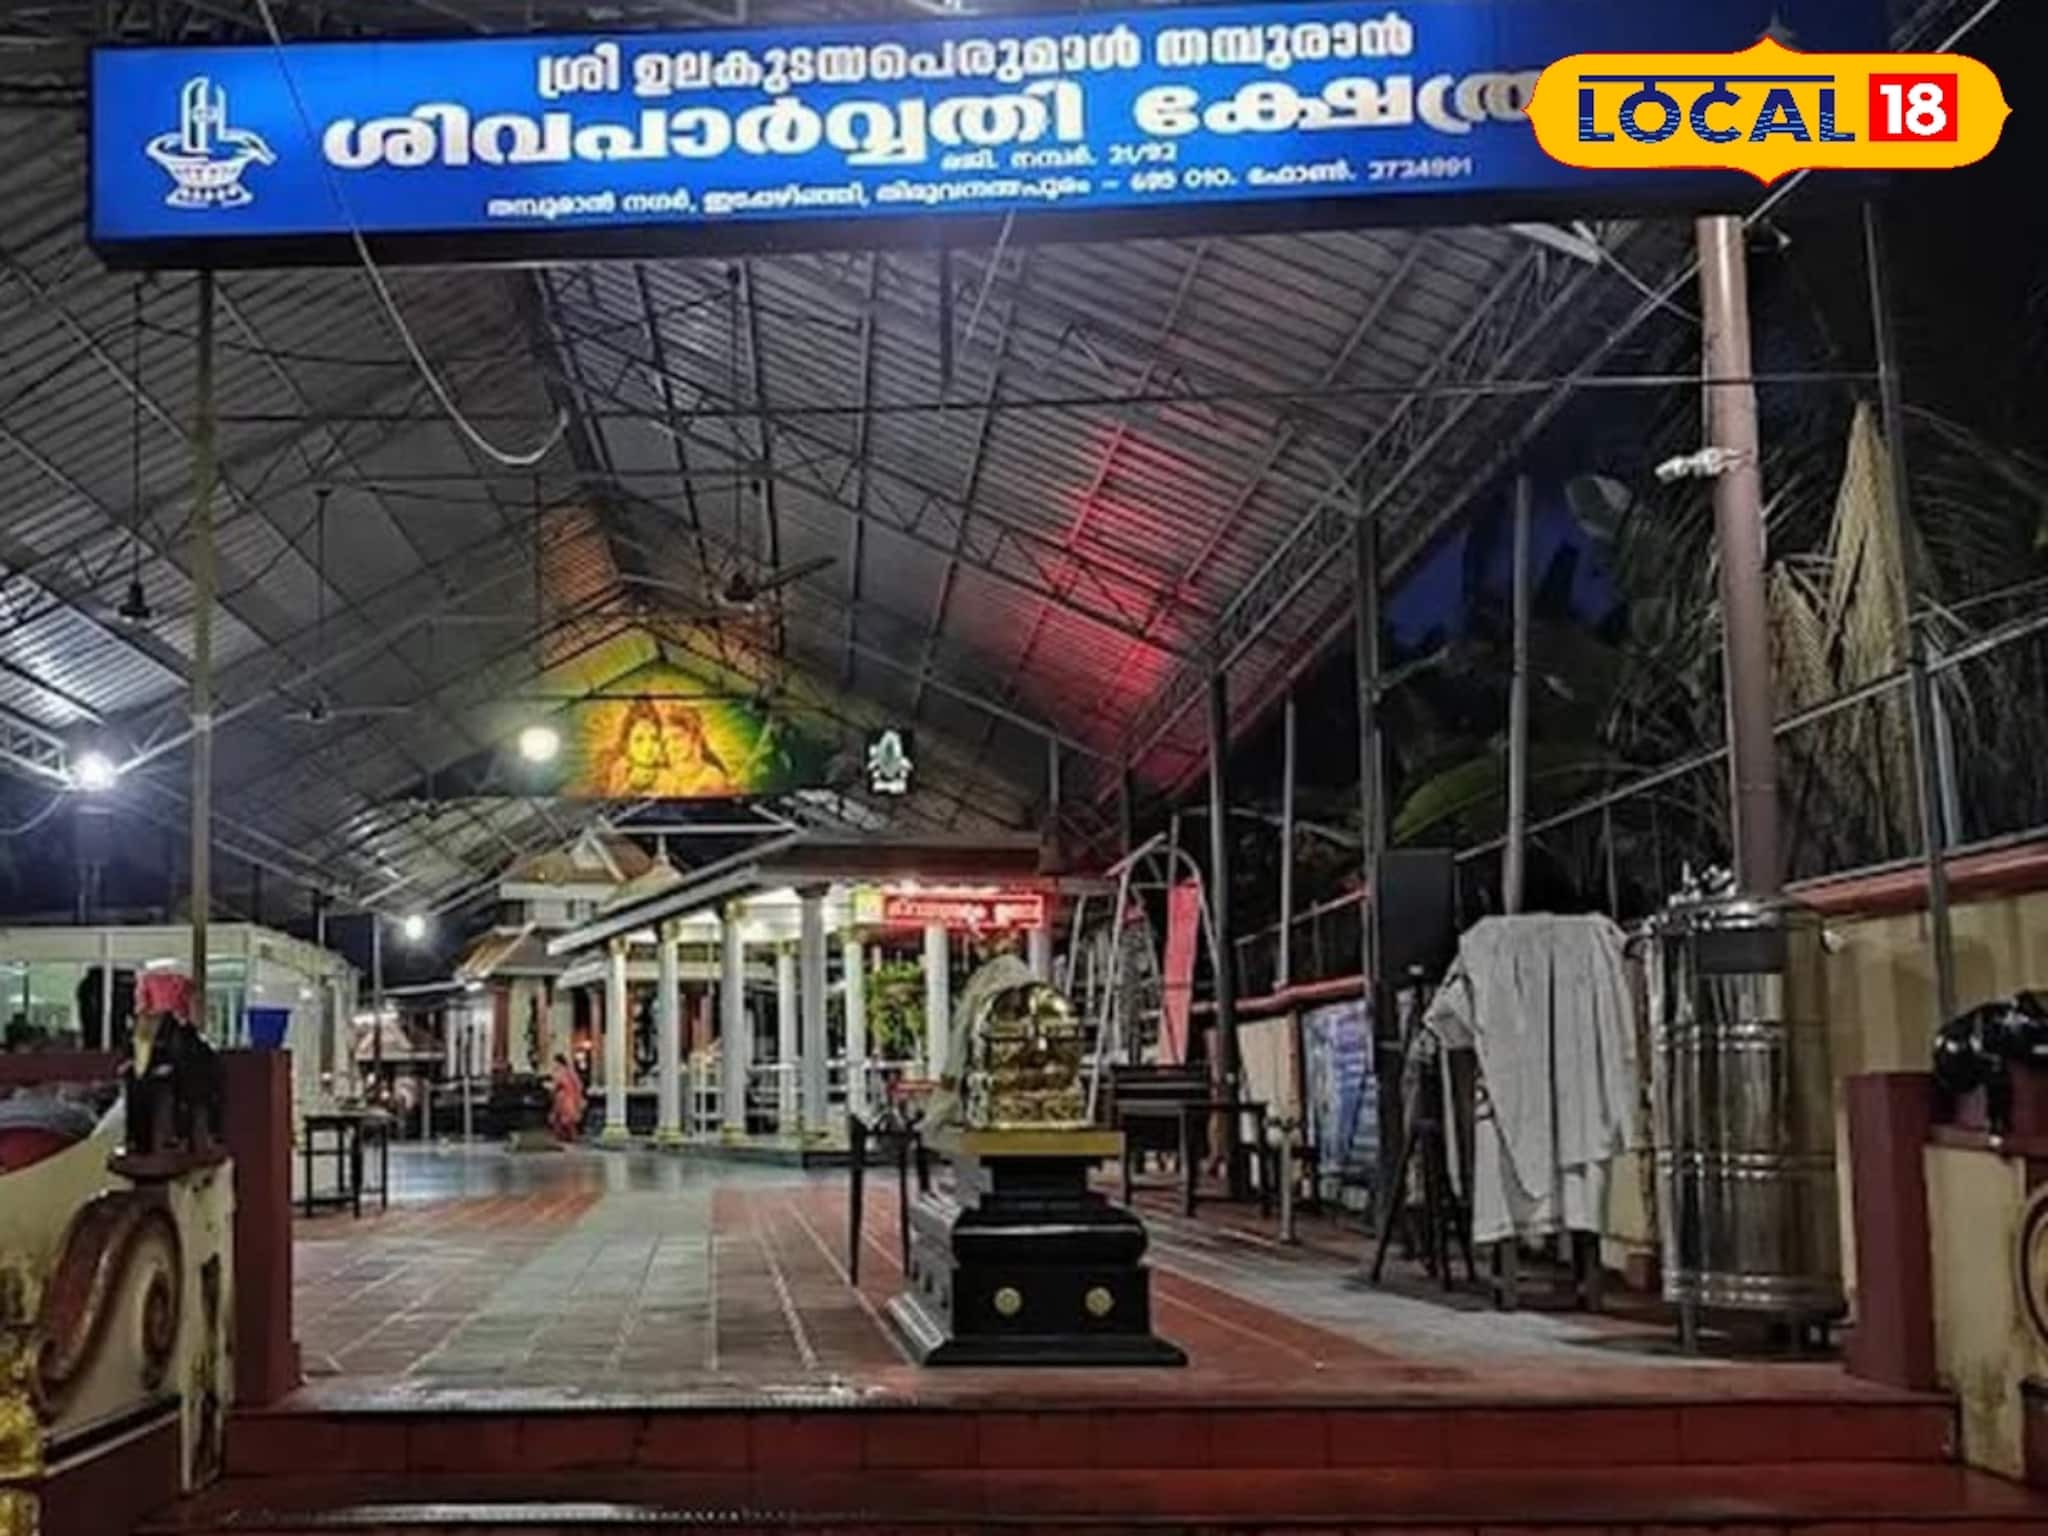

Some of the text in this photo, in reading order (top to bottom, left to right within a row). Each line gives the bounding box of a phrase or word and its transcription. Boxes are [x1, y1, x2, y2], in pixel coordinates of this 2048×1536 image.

[538, 43, 620, 98] ശ്രീ
[1155, 12, 1413, 71] തമ്പുരാൻ
[1133, 71, 1536, 137] ക്ഷേത്ര
